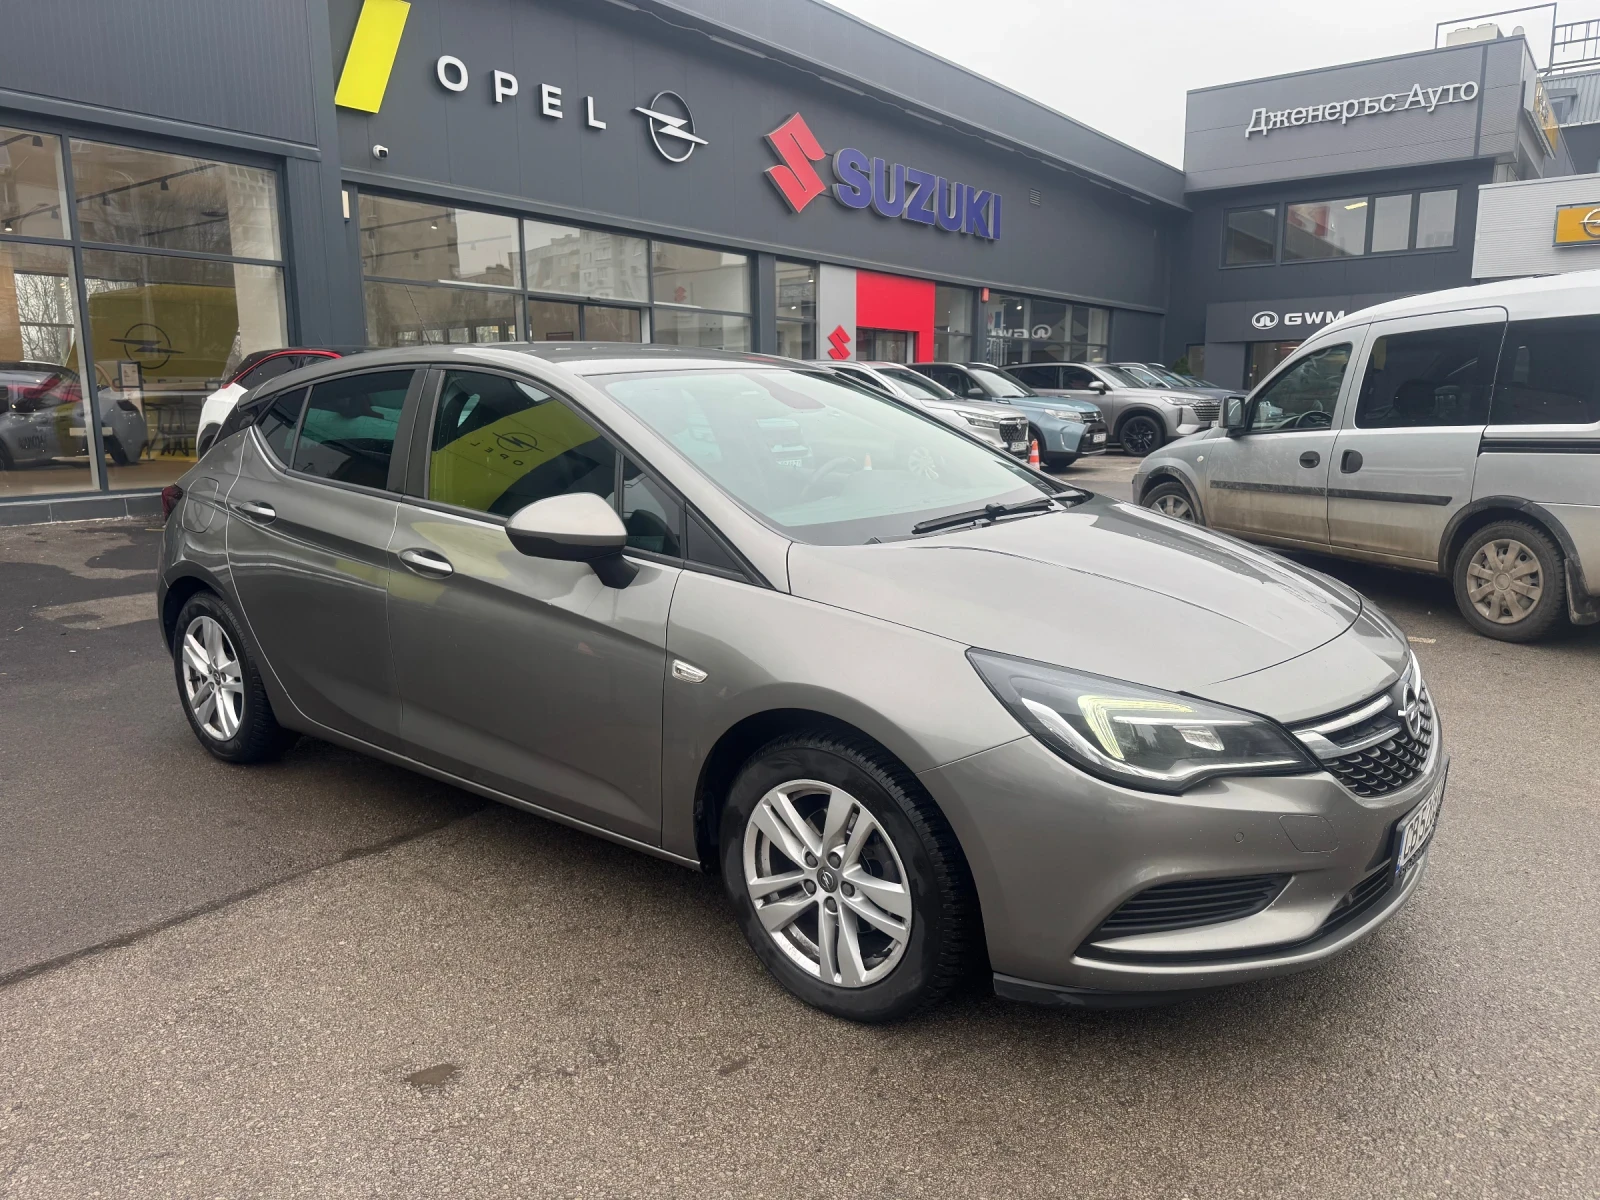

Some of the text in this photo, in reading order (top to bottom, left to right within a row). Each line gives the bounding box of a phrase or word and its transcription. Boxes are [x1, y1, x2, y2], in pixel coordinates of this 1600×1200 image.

[436, 54, 607, 130] OPEL
[1244, 80, 1479, 138] Дженеръс Ауто
[832, 147, 1002, 240] SUZUKI
